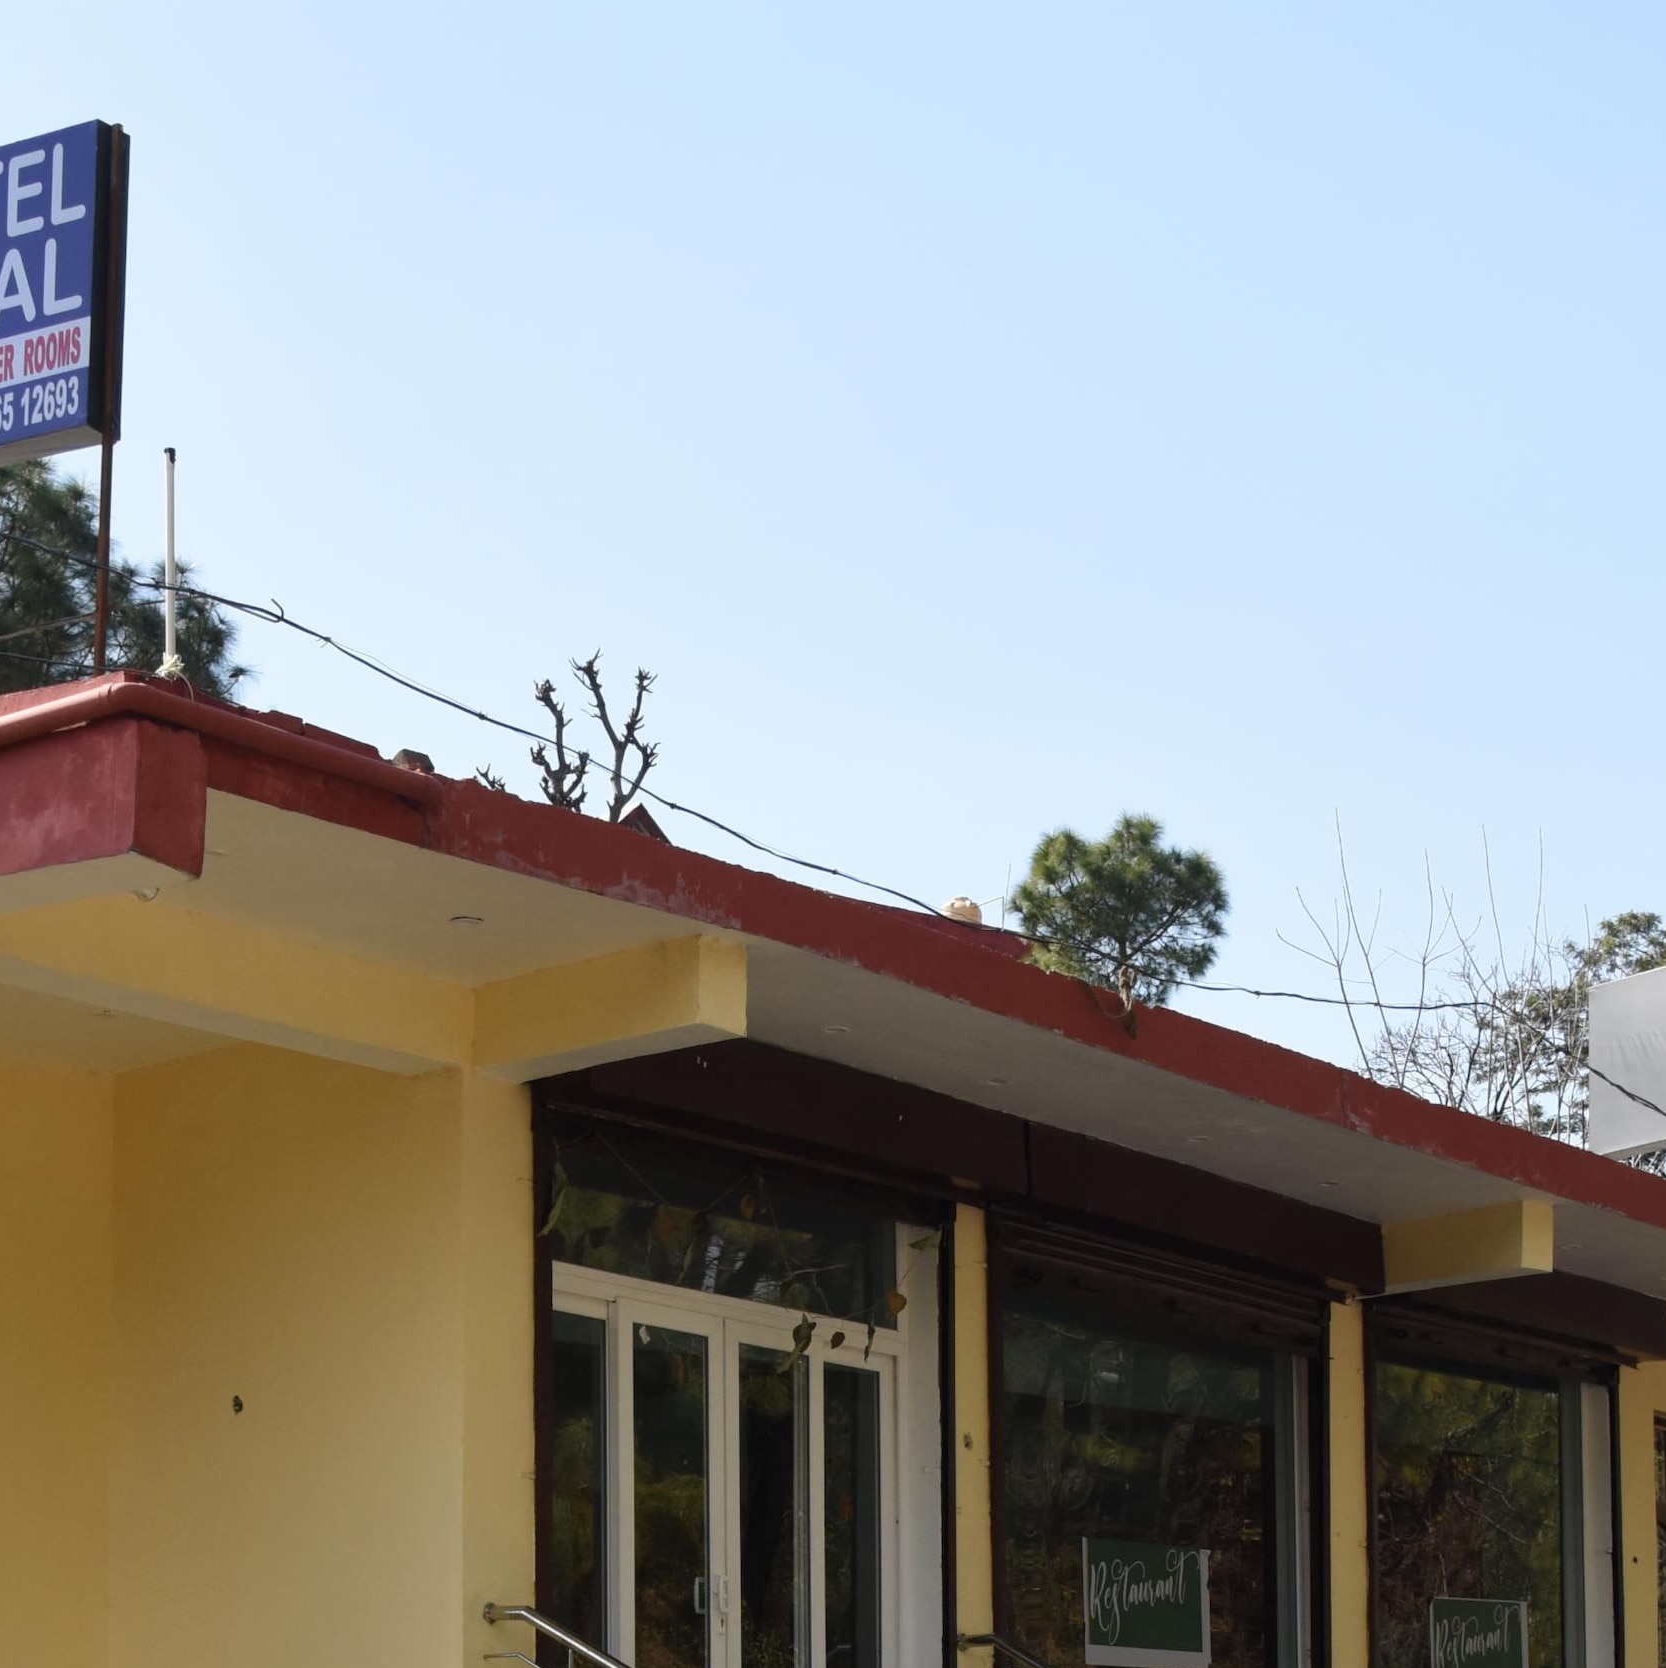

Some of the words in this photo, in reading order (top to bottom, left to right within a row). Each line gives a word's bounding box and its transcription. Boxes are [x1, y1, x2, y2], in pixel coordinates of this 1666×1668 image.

[23, 326, 81, 376] ROOMS
[21, 376, 78, 425] 12693
[1090, 1549, 1200, 1645] Restaurant
